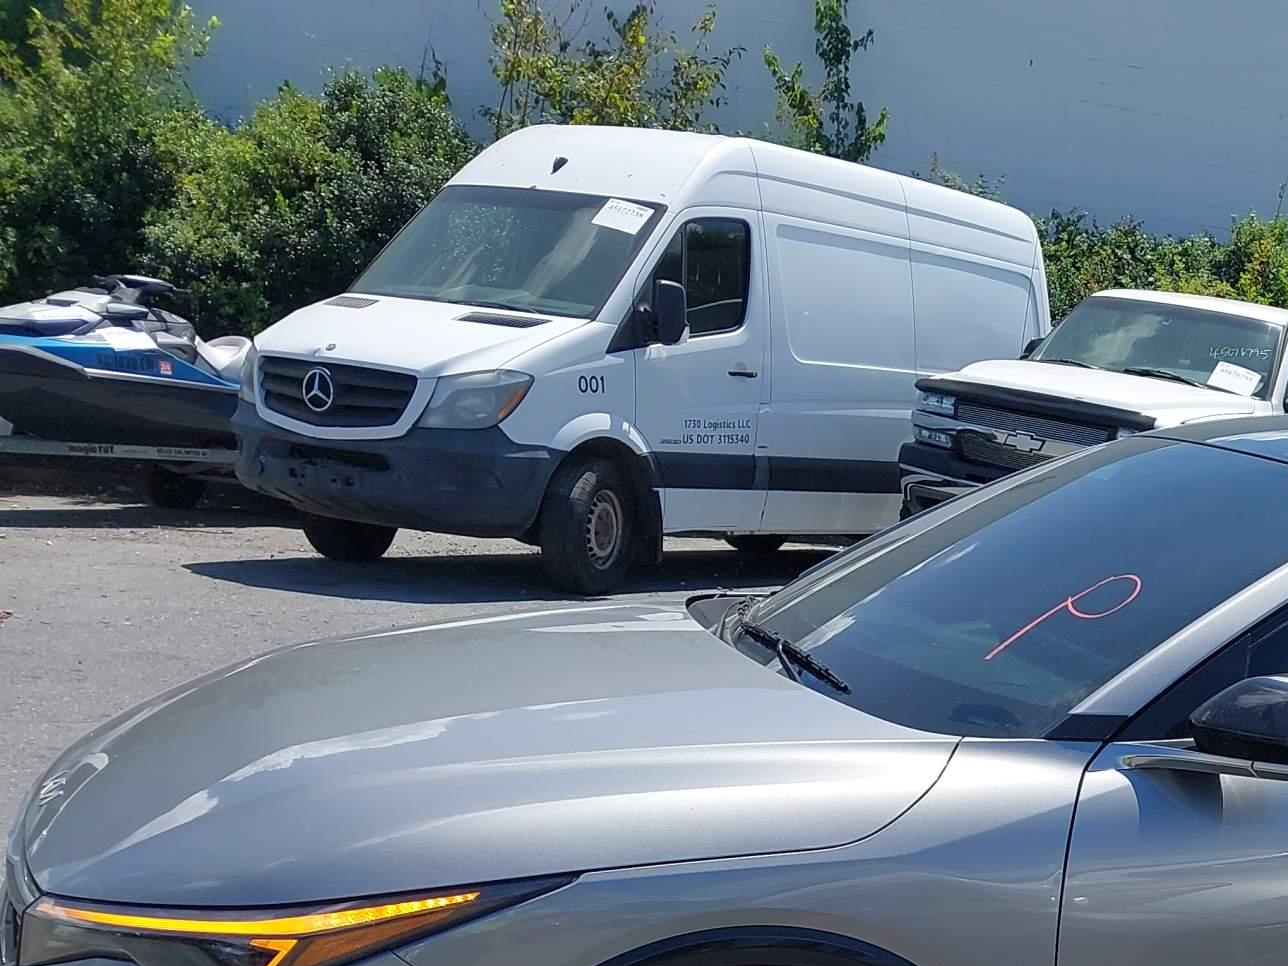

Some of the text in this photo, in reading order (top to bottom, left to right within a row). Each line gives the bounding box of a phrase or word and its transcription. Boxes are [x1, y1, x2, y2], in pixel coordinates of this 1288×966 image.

[578, 375, 606, 394] 001
[684, 419, 751, 432] 1730 Logistics LLC
[682, 433, 694, 445] US
[696, 434, 714, 445] DOT
[718, 434, 750, 445] 3115340
